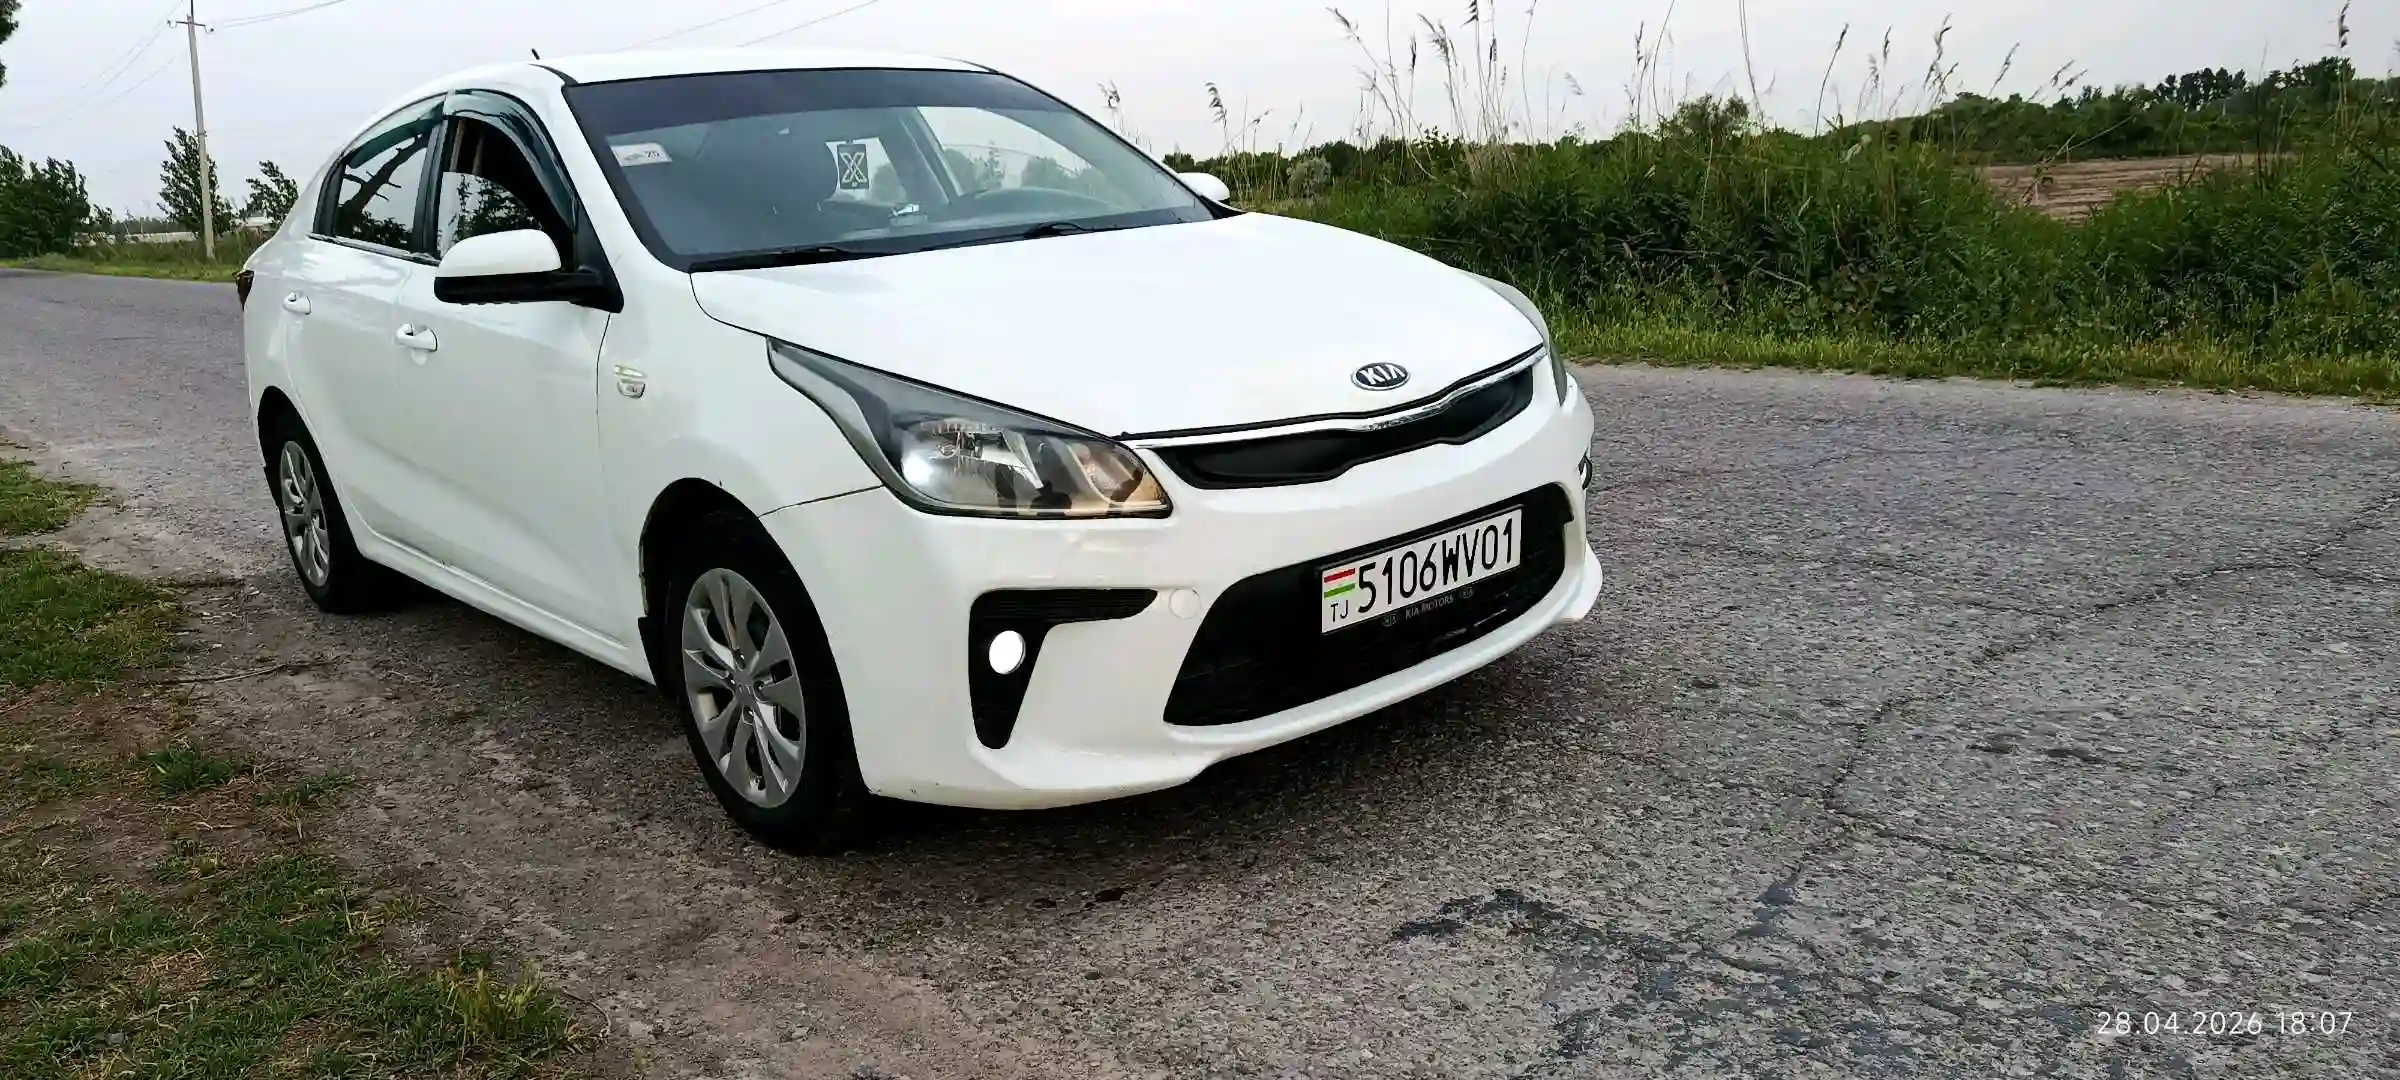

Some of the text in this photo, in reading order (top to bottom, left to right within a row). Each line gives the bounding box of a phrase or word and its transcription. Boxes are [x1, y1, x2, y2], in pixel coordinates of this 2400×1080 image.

[1359, 364, 1406, 385] KIA
[1357, 518, 1514, 613] 5106WV01
[1330, 600, 1349, 622] TJ
[1405, 607, 1420, 620] KIA
[1422, 595, 1454, 613] MOTORS
